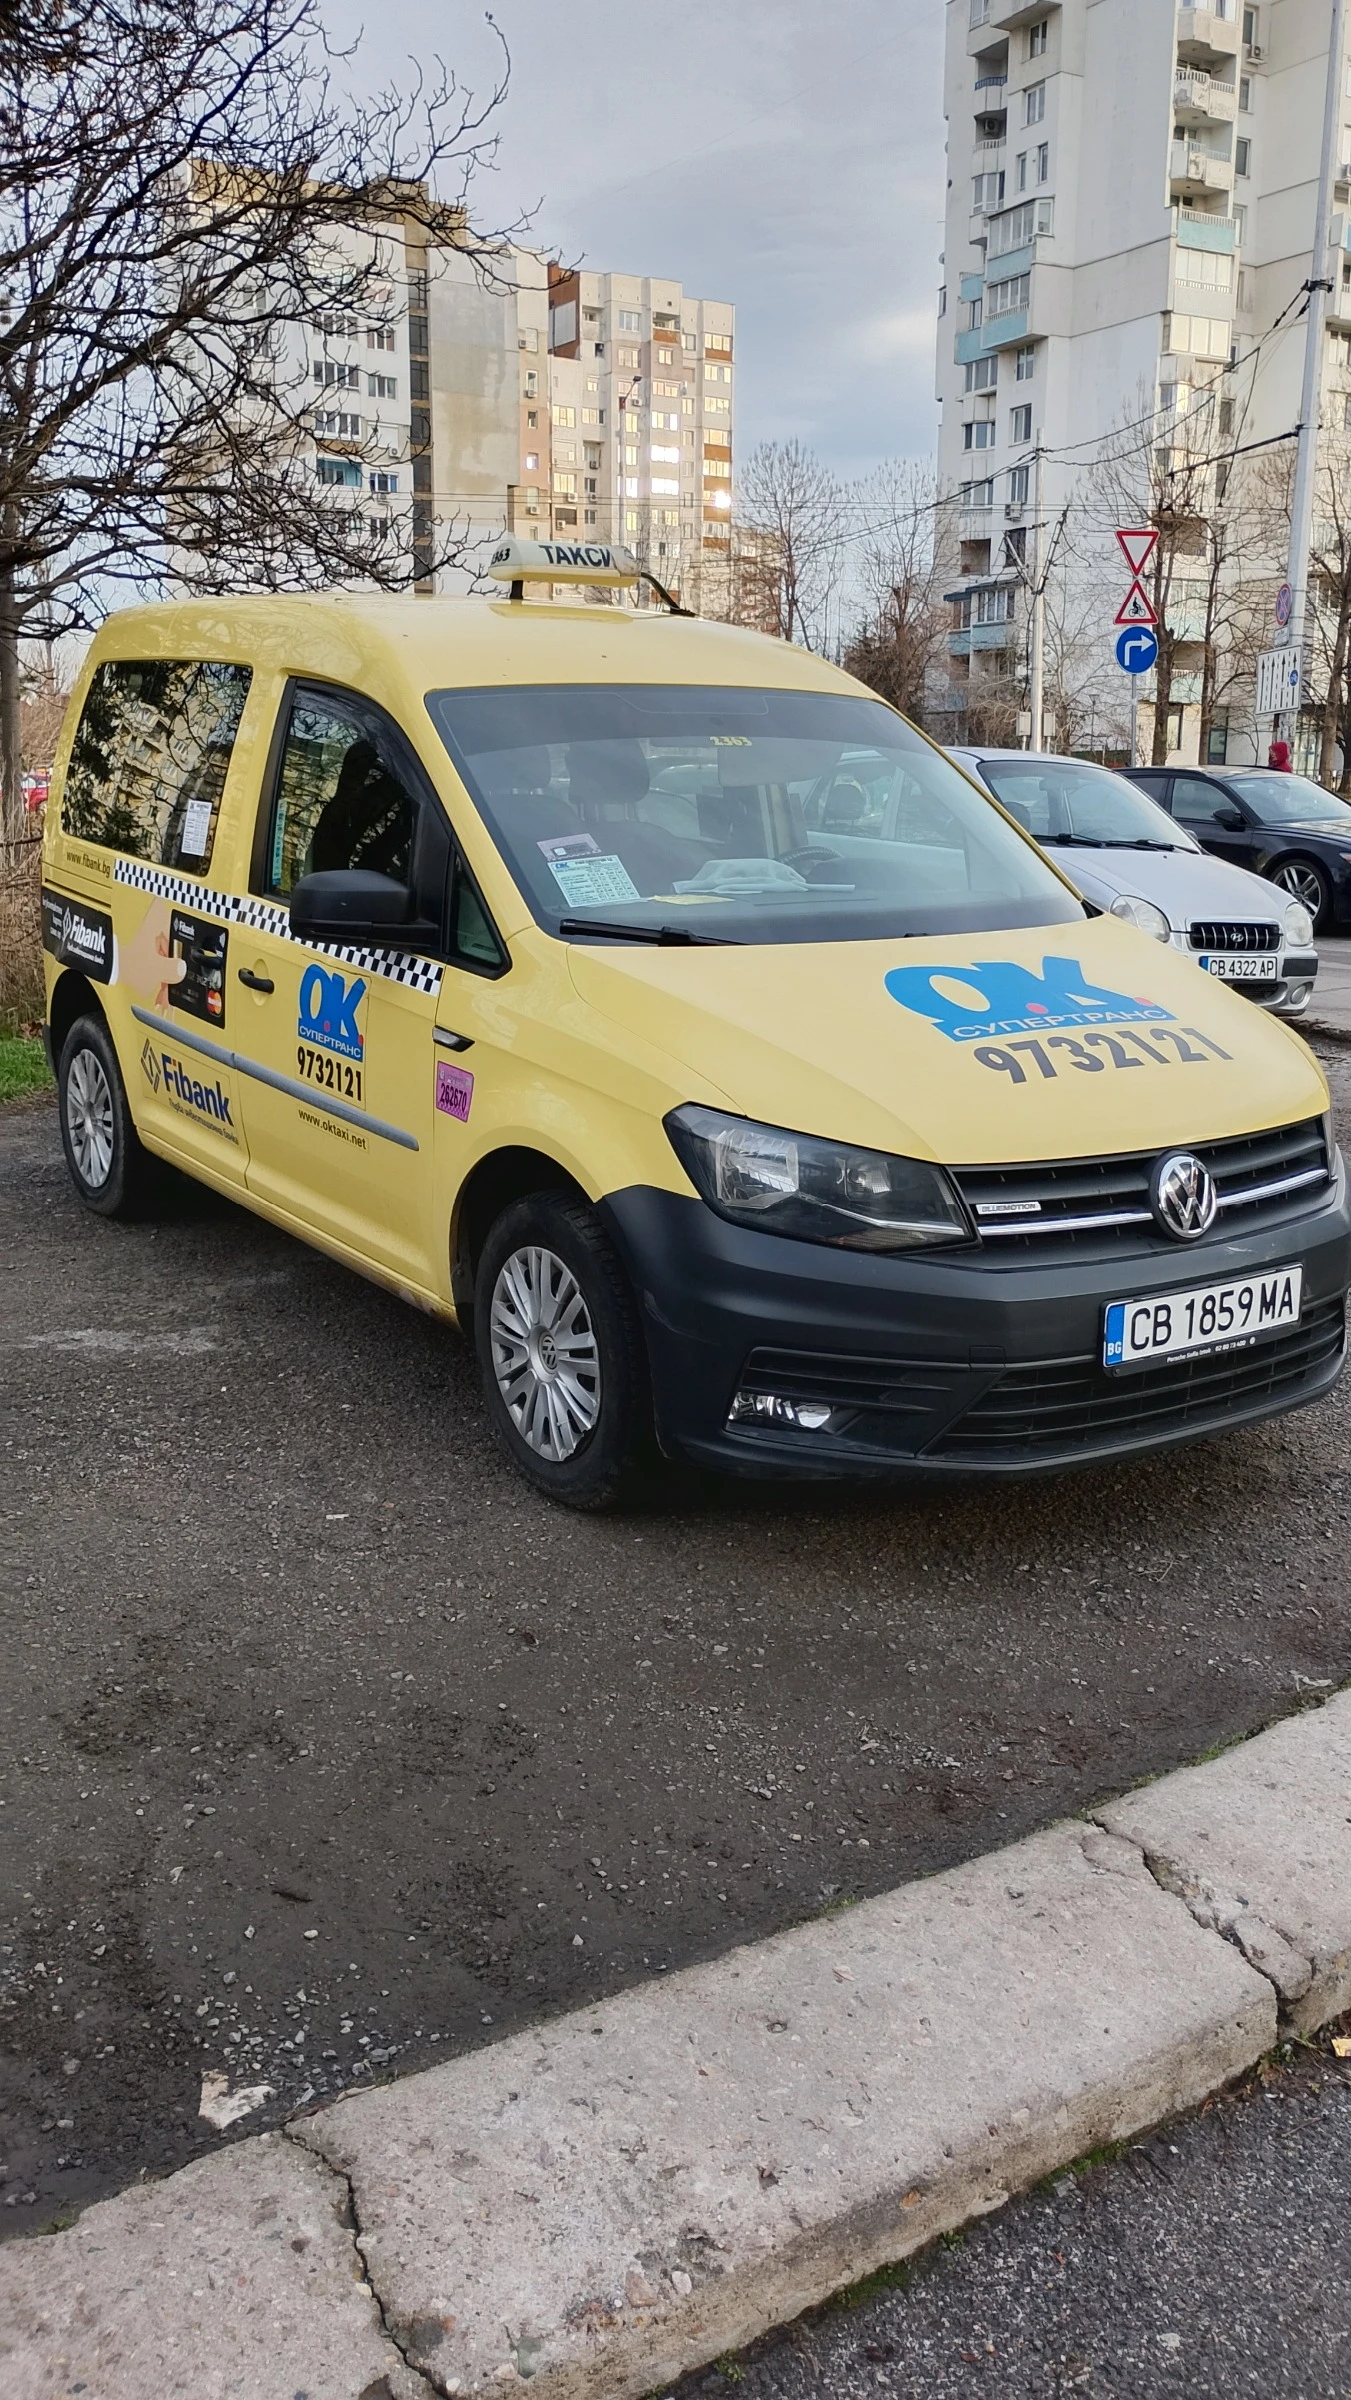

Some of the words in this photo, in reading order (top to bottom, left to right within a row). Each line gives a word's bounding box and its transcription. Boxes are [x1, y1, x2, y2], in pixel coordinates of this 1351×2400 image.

[709, 736, 752, 746] 2363
[66, 850, 111, 878] www.fibank.bg
[70, 914, 106, 954] Fibank
[1229, 960, 1257, 976] 4322
[953, 1008, 1168, 1039] СУПЕРТРАНС
[299, 1025, 362, 1058] СУПЕРТРАНС
[973, 1027, 1234, 1084] 9732121
[161, 1052, 234, 1127] Fibank
[297, 1046, 362, 1101] 9732121
[440, 1082, 468, 1112] 262670
[298, 1109, 367, 1150] www.oktaxi.net
[1185, 1286, 1253, 1340] 1859
[1107, 1341, 1122, 1356] BG
